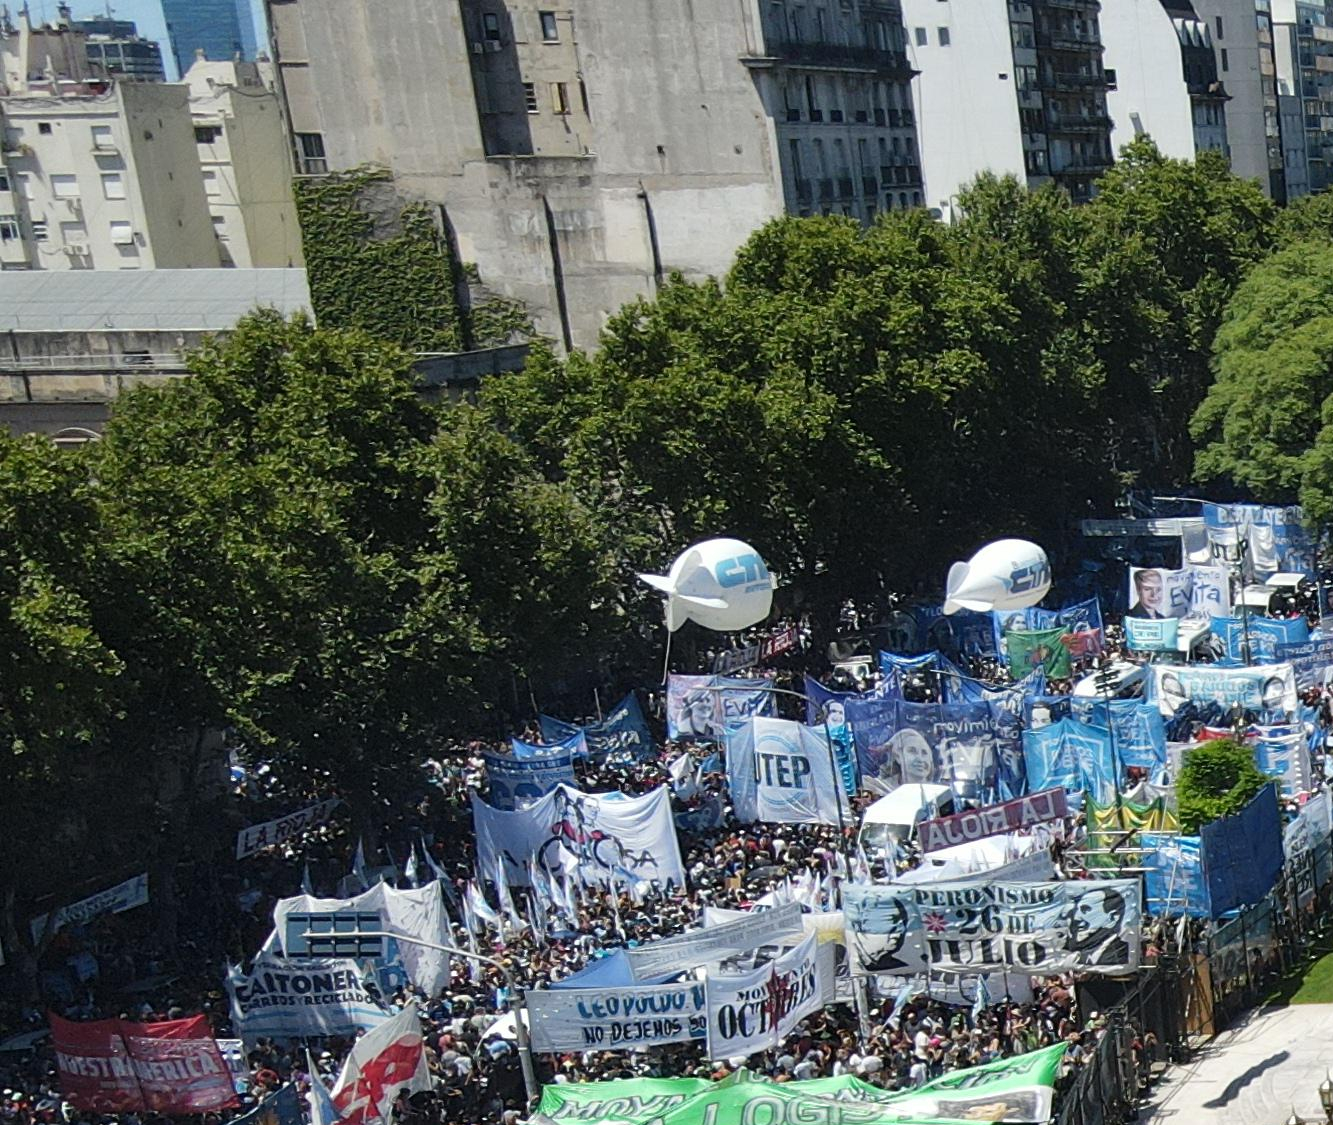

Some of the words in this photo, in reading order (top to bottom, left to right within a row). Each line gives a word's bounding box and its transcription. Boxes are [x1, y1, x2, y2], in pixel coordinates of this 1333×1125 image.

[913, 885, 1056, 908] PERONISMO
[957, 904, 1002, 935] 26
[1007, 915, 1036, 935] DE
[928, 937, 1046, 966] JULIO
[582, 1026, 604, 1045] NO
[611, 1018, 682, 1045] DEJEMOS
